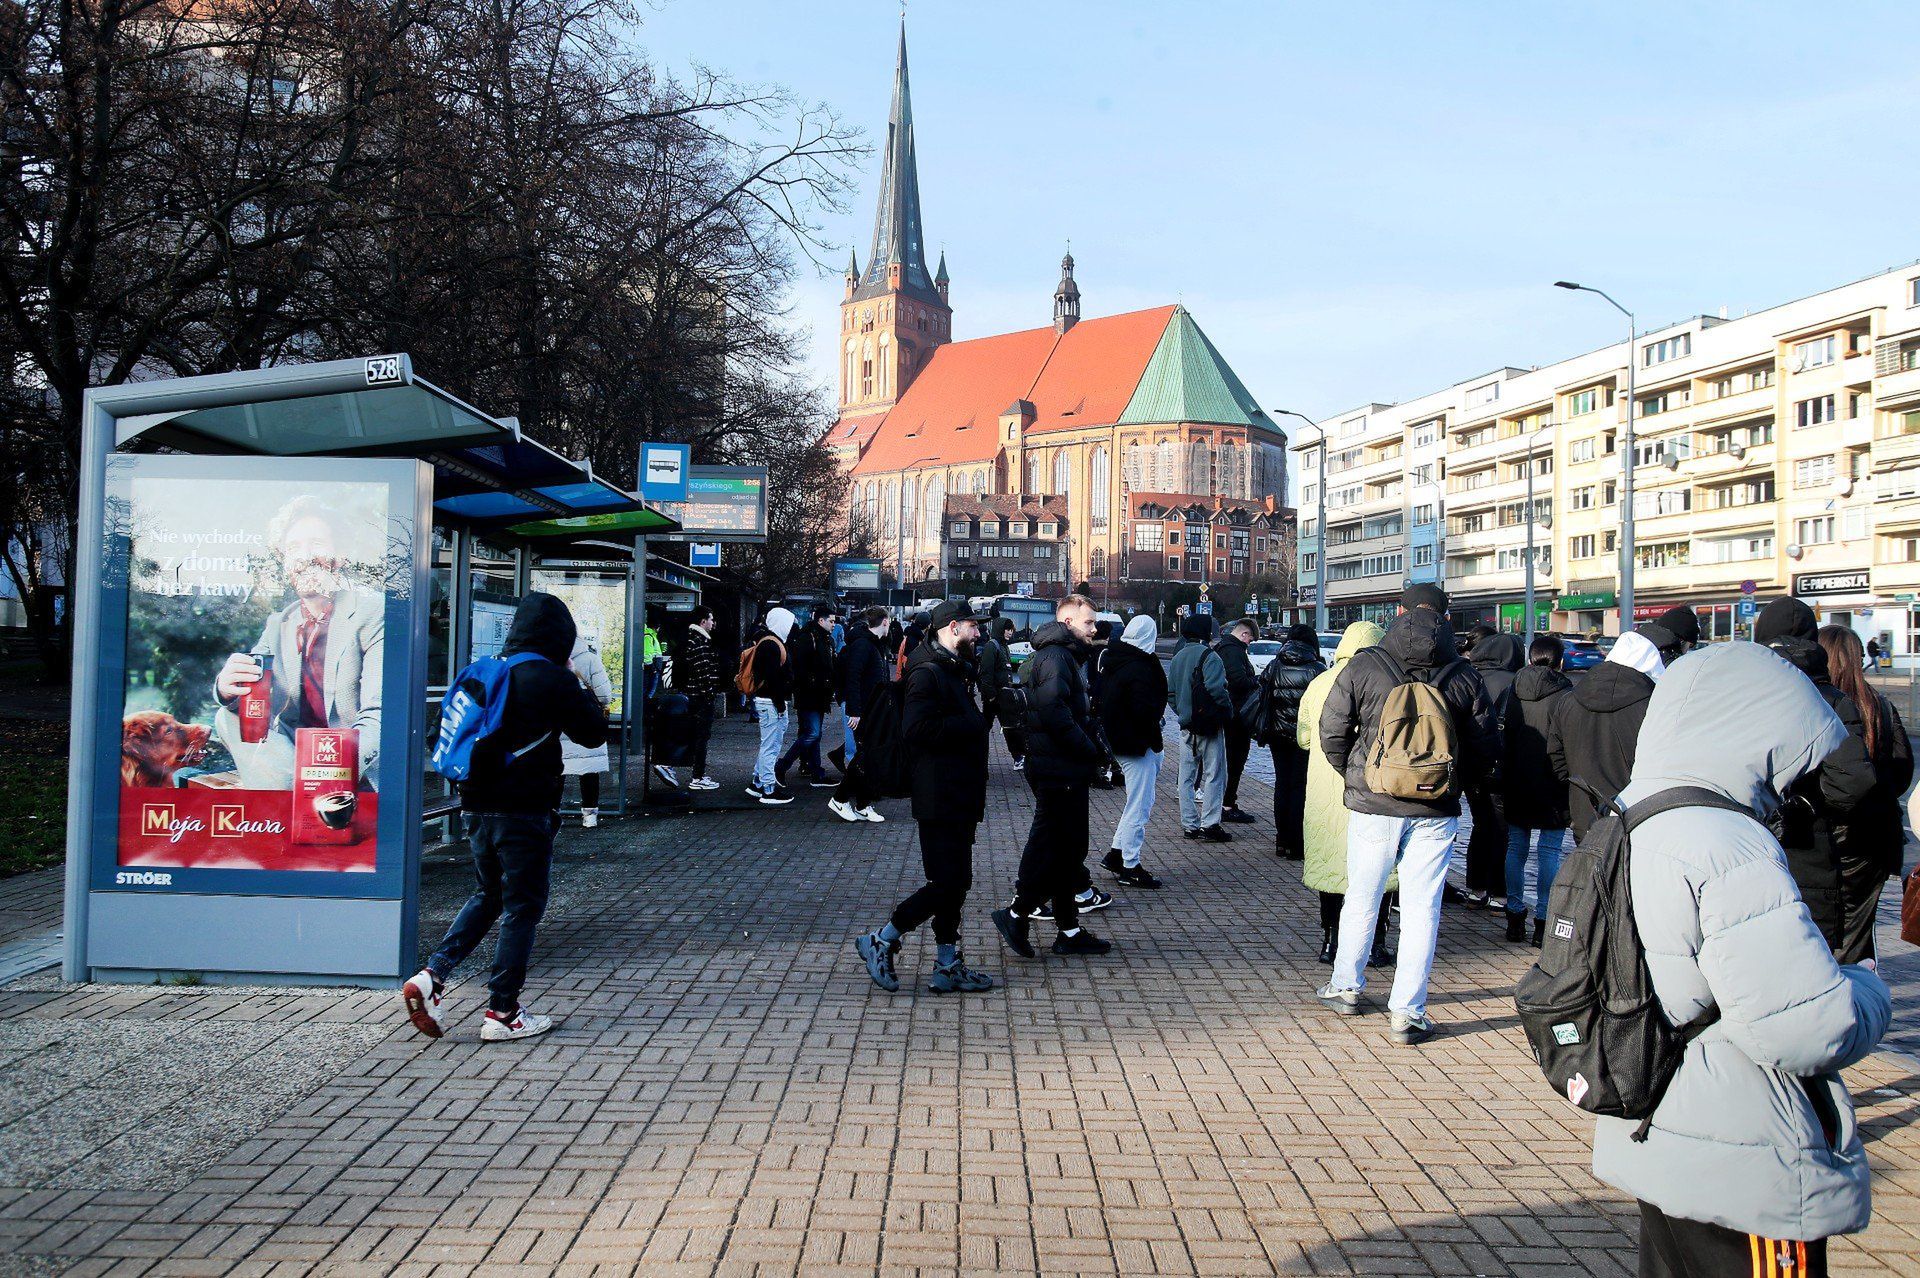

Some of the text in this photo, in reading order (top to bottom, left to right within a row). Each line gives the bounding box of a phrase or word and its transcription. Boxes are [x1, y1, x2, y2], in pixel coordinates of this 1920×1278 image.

[368, 358, 398, 381] 528
[688, 481, 733, 491] szyńskiego
[150, 529, 263, 549] Nie wychodzę
[163, 550, 249, 572] z domu
[157, 575, 194, 596] bez
[1801, 574, 1869, 591] E-PAPIEROSY.PL
[318, 741, 337, 754] MK
[306, 770, 347, 778] PREMIUM
[148, 809, 205, 843] Moja
[218, 811, 286, 834] Kawa
[115, 872, 172, 886] STRÖER
